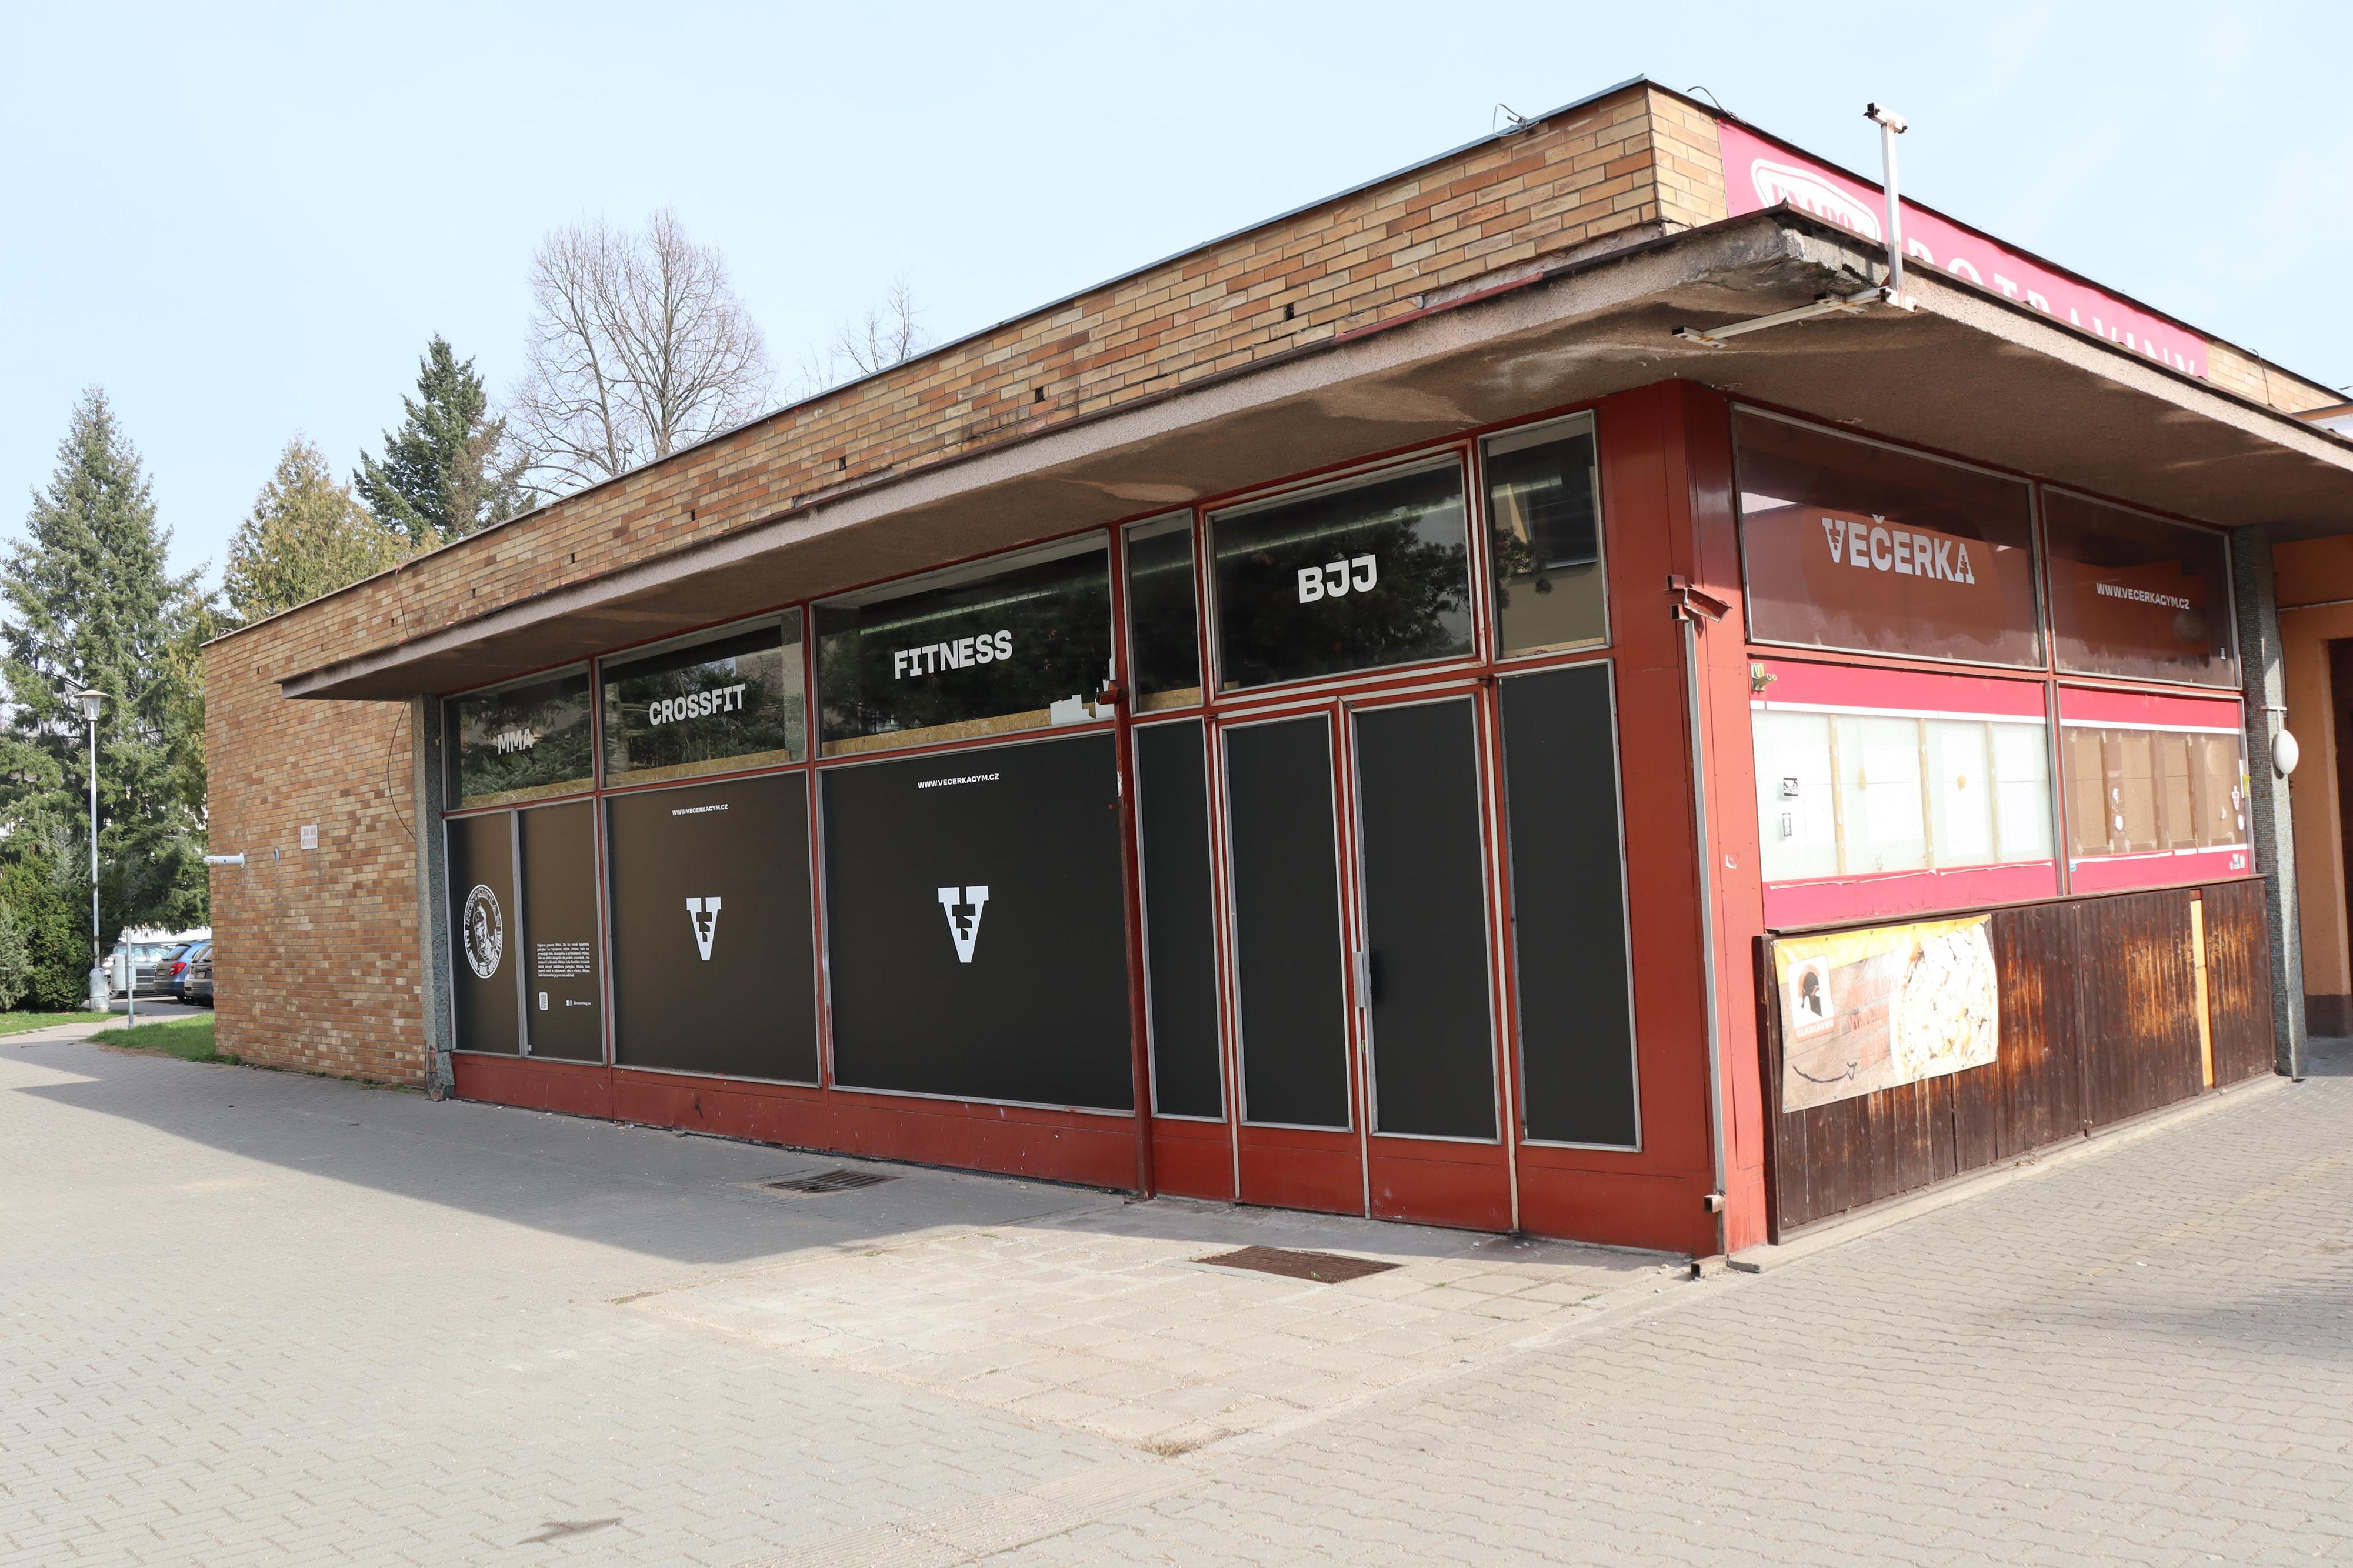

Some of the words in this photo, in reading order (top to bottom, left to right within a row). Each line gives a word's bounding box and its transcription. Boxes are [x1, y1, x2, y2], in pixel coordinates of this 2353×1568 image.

[1822, 513, 1975, 585] VEČERKA
[1298, 554, 1377, 604] BJJ
[2096, 583, 2190, 610] WWW.VECERKAGYM.CZ
[894, 630, 1013, 680] FITNESS
[649, 683, 746, 726] CROSSFIT
[498, 728, 533, 755] MMA
[918, 773, 999, 789] WWW.VECERKAGYM.CZ
